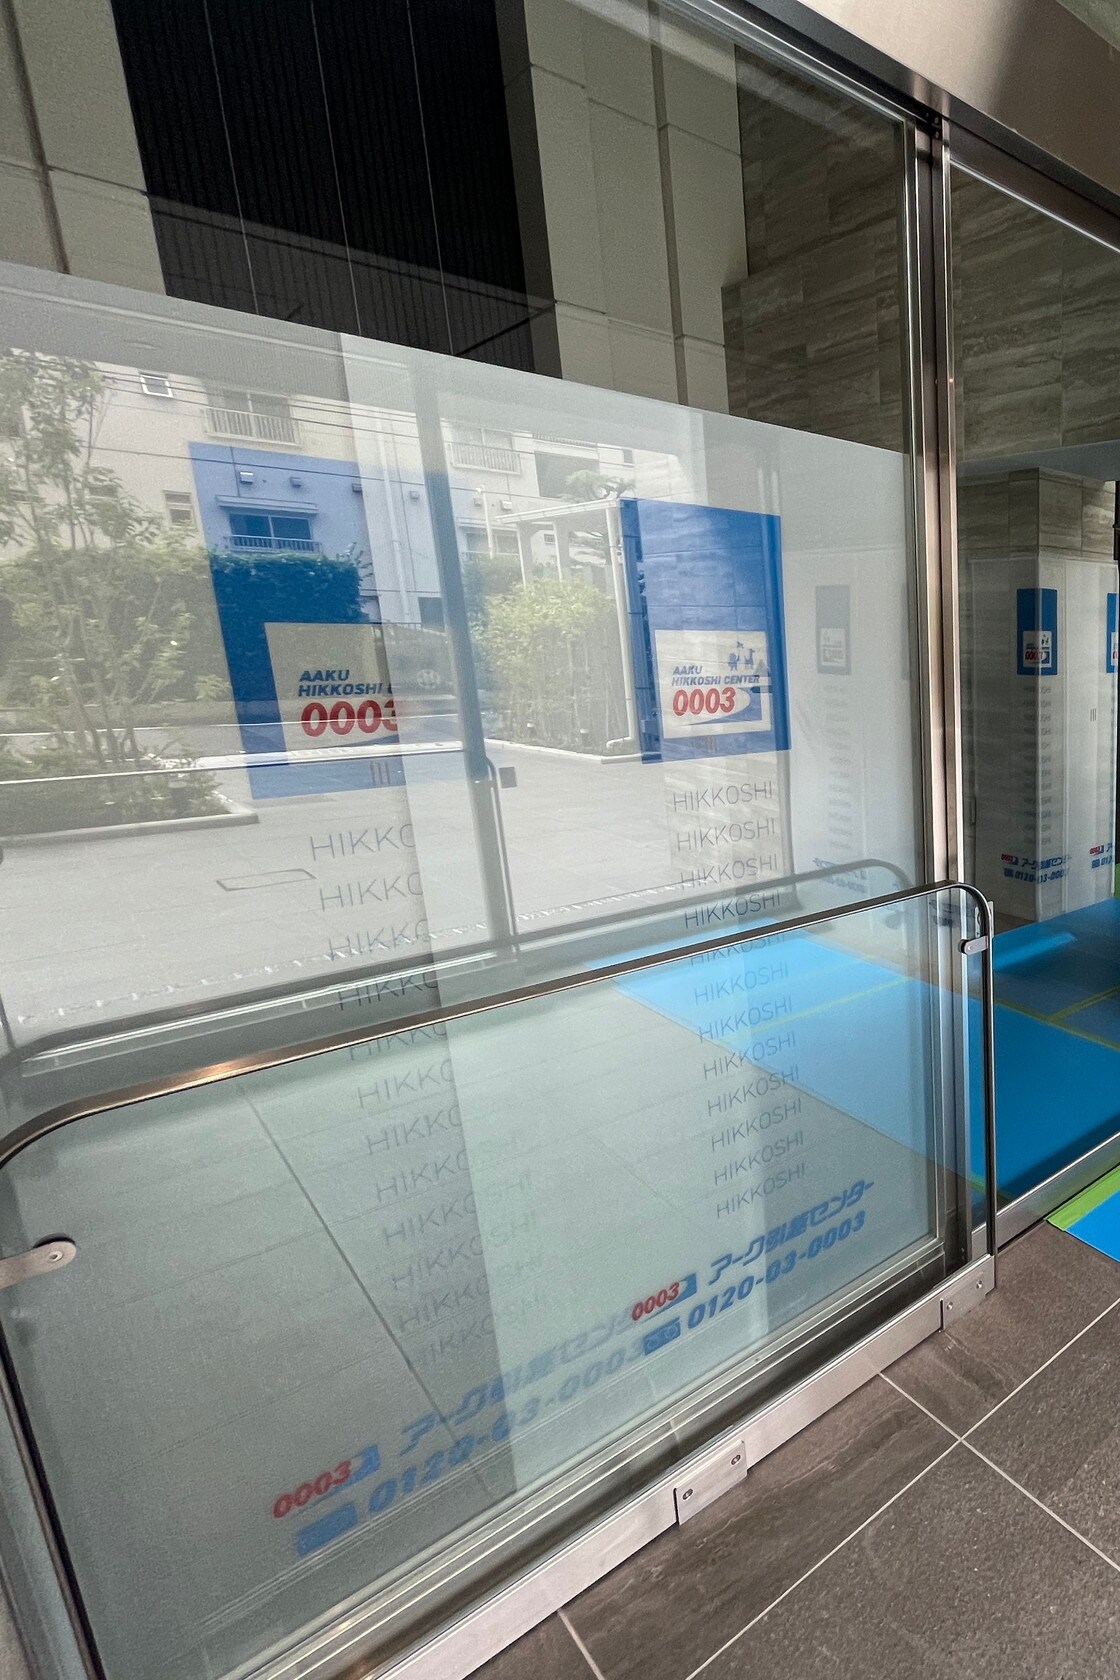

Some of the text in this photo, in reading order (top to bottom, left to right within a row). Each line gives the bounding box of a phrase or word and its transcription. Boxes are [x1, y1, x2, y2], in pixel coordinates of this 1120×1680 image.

[298, 682, 383, 697] HIKKOSHI
[299, 669, 349, 682] AAKU
[672, 665, 703, 675] AAKU
[672, 675, 760, 687] HIKKOSHI CENTER
[672, 687, 736, 716] 0003
[673, 781, 774, 812] HIKKOSHI
[677, 818, 776, 851] HIKKOSHI
[680, 854, 778, 890] HIKKOSHI
[685, 890, 781, 928] HIKKOSHI
[694, 962, 789, 1006] HIKKOSHI
[699, 996, 793, 1043] HIKKOSHI
[703, 1030, 796, 1080] HIKKOSHI
[708, 1064, 799, 1117] HIKKOSHI
[711, 1097, 802, 1152] HIKKOSHI
[715, 1131, 804, 1186] HIKKOSHI
[717, 1162, 806, 1219] HIKKOSHI
[687, 1210, 866, 1329] 0120-03-0003
[631, 1282, 680, 1322] 0003
[273, 1460, 351, 1518] 0003
